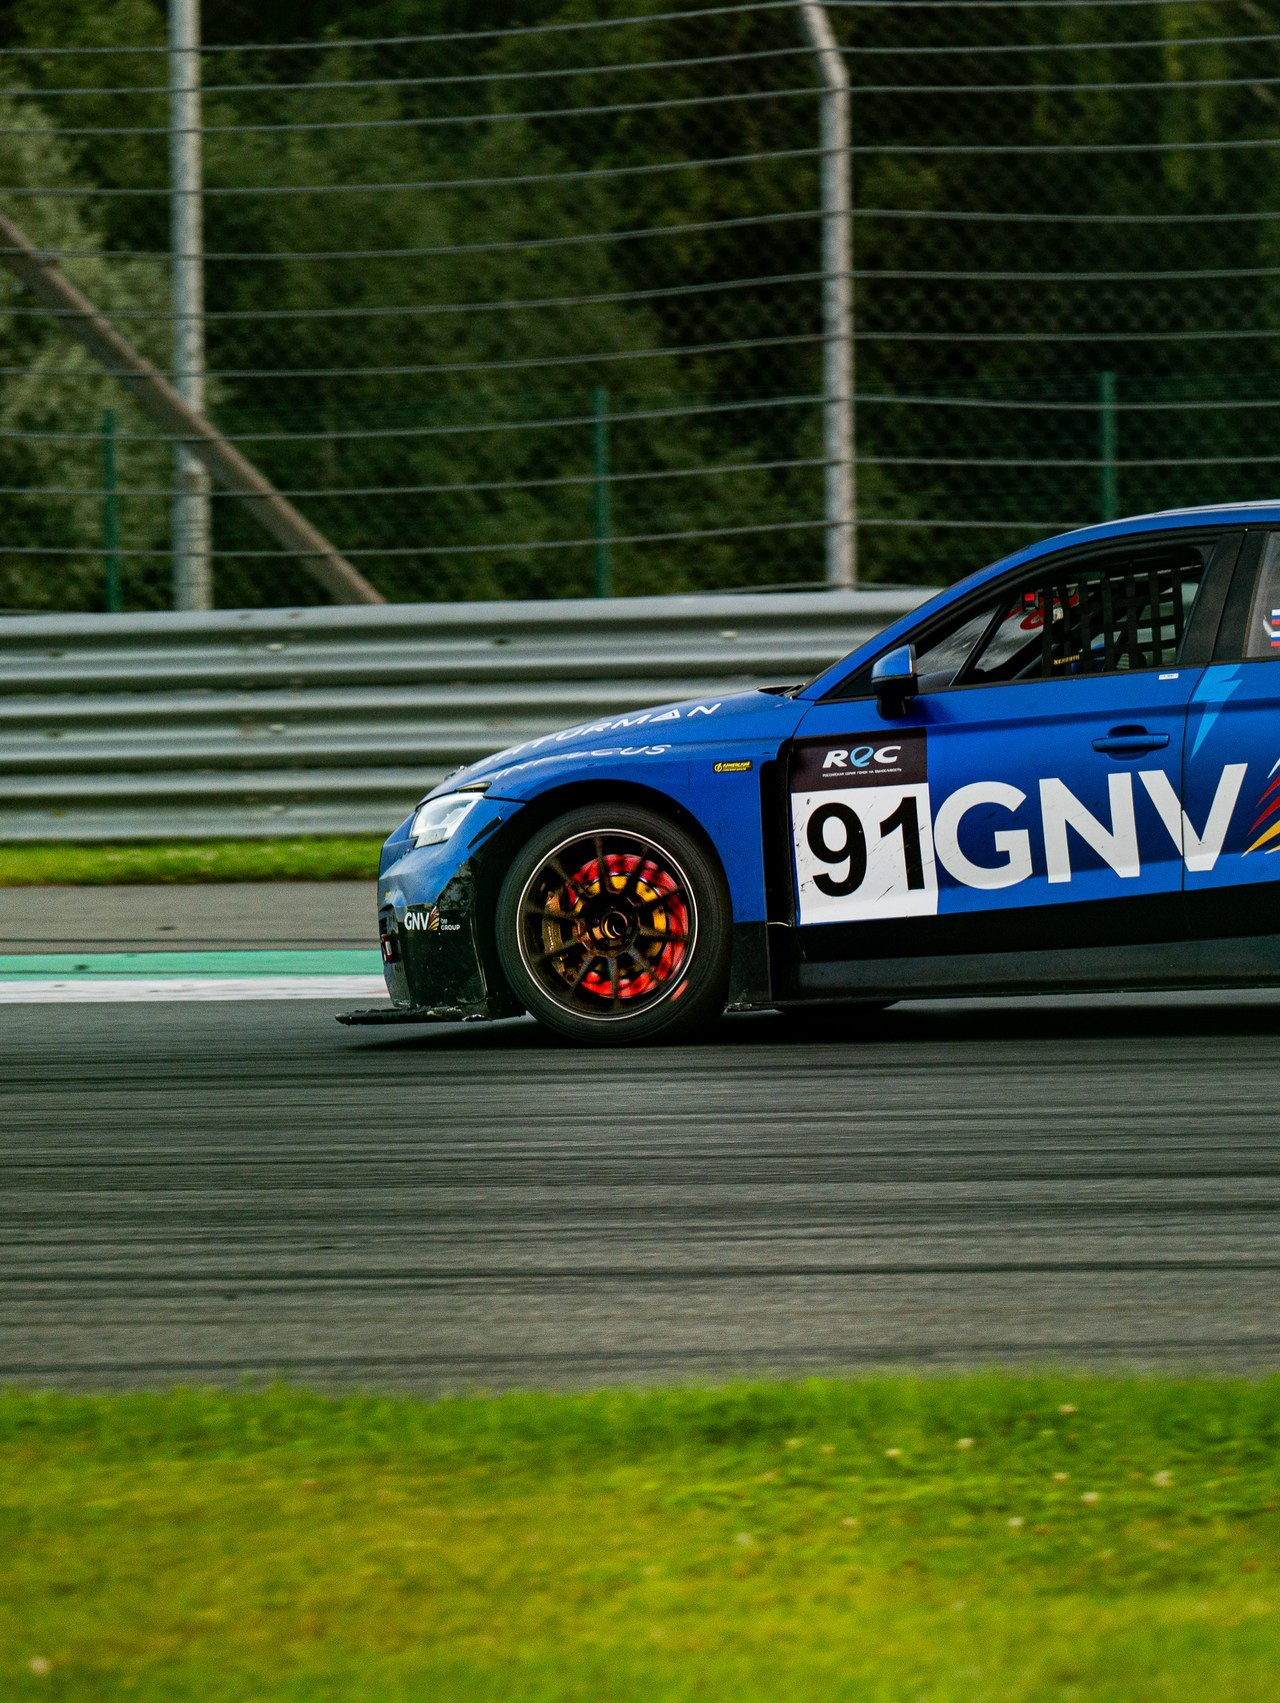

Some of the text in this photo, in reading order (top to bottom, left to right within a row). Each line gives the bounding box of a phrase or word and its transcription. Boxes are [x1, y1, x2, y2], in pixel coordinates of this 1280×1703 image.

[806, 796, 927, 897] 91
[933, 762, 1249, 890] GNV
[404, 912, 430, 930] GNV
